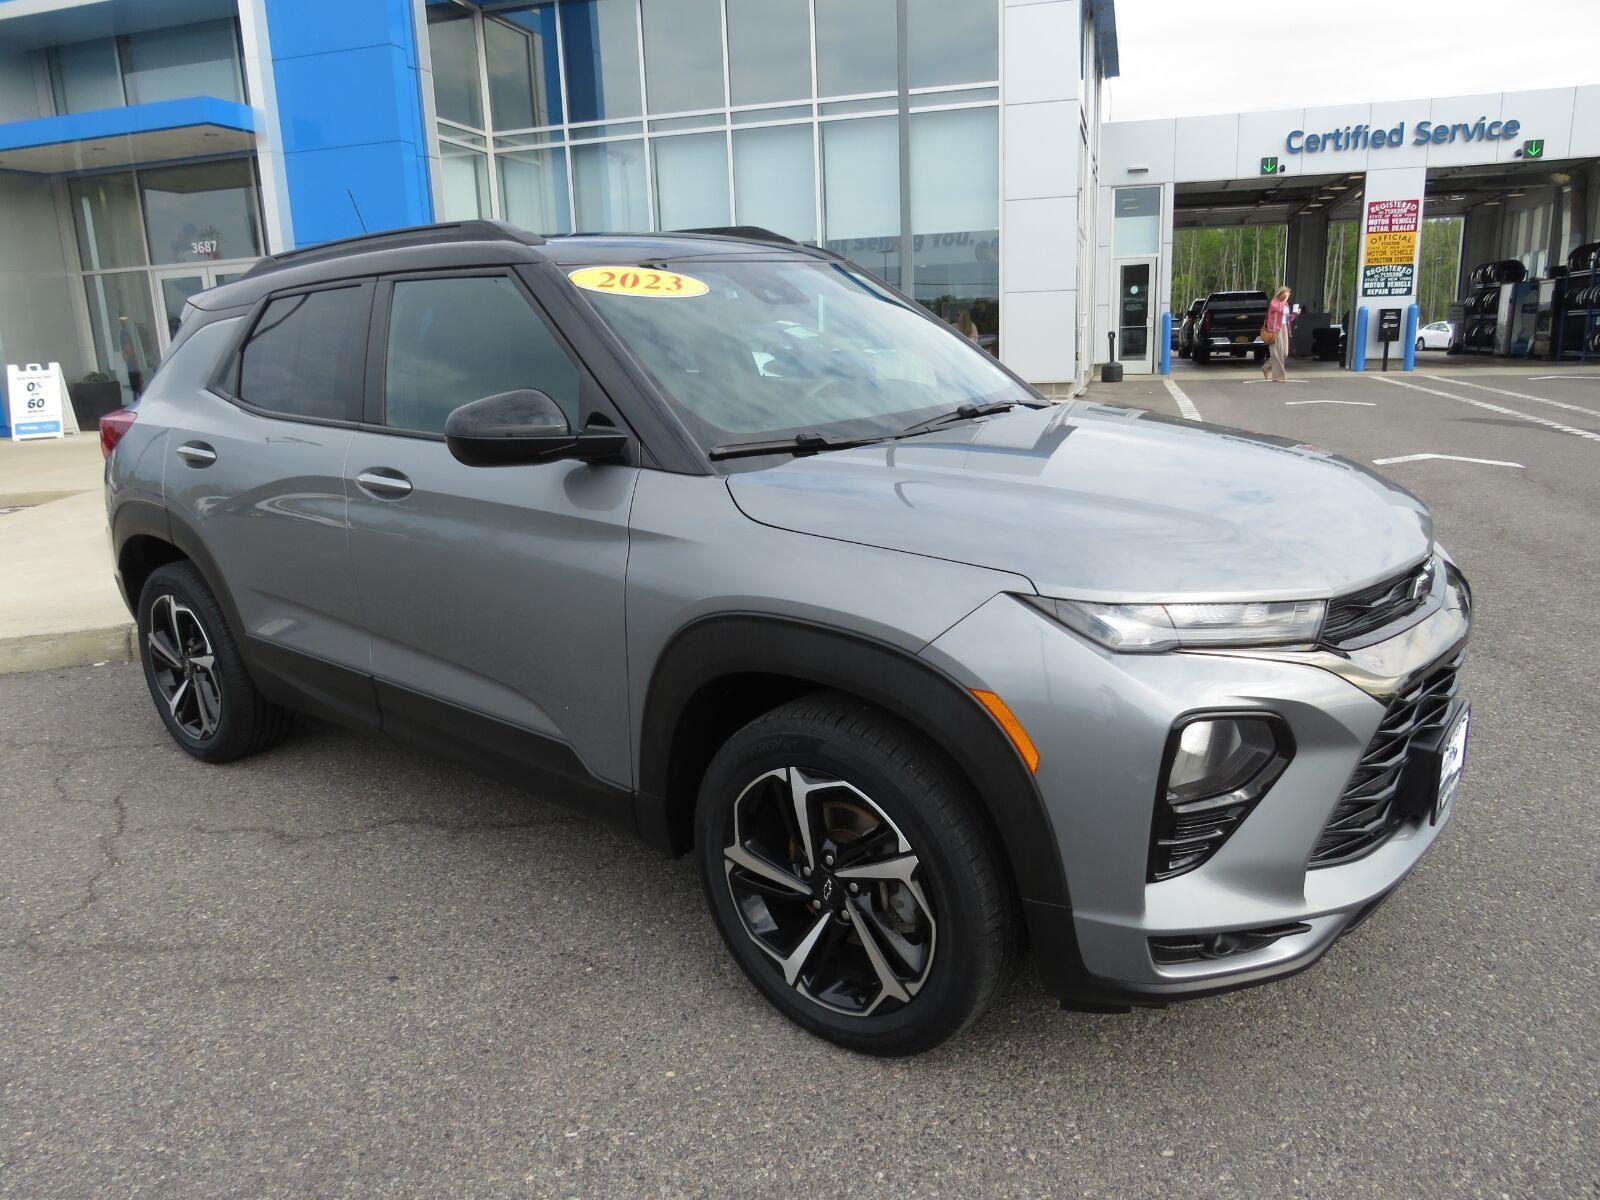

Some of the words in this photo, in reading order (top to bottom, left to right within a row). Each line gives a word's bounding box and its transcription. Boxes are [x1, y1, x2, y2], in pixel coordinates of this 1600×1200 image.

[1286, 122, 1405, 154] Certified
[1412, 116, 1521, 145] Service
[1370, 201, 1417, 213] REGISTERED
[1370, 234, 1412, 244] OFFICIAL
[192, 240, 217, 254] 3687
[1366, 265, 1412, 276] REGISTERED
[597, 271, 683, 292] 2023
[1387, 280, 1412, 288] VEHICLE
[27, 398, 45, 409] 60
